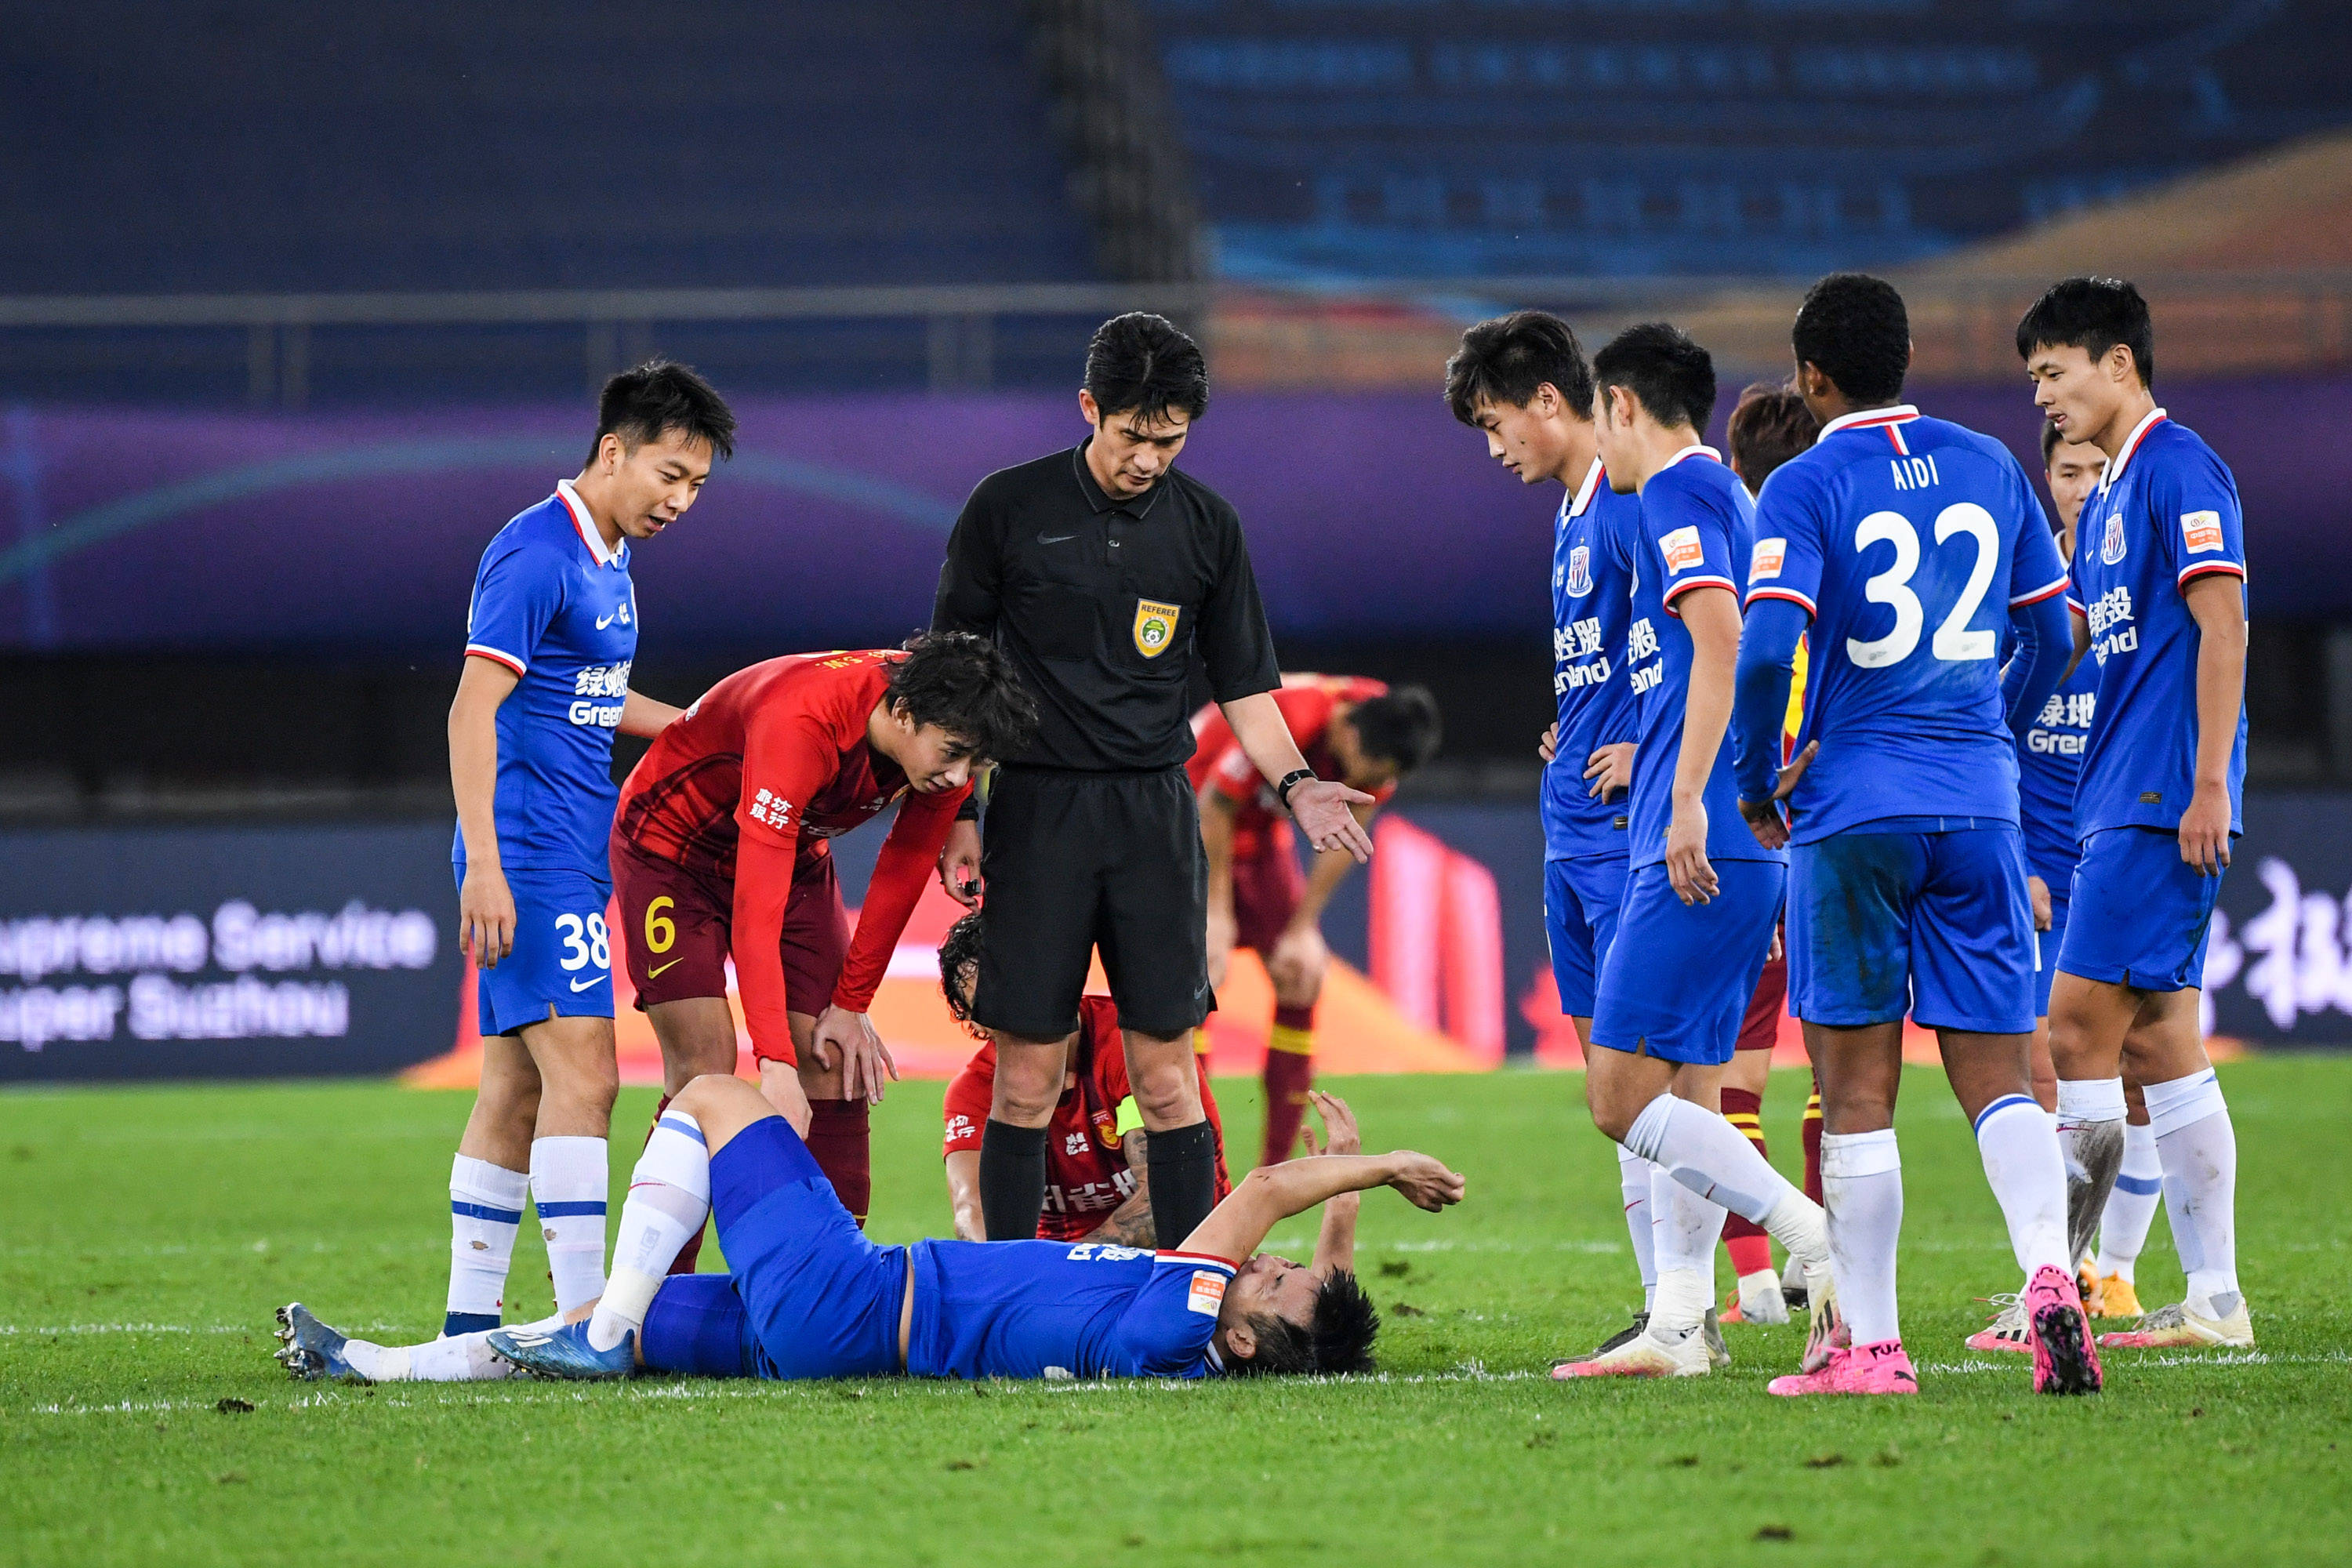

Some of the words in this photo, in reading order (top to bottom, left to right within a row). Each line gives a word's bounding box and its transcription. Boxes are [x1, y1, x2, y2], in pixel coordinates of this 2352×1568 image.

[1889, 454, 1940, 491] AIDI
[1141, 604, 1177, 617] REFEREE
[1846, 502, 1999, 669] 32
[212, 899, 437, 971] Service
[555, 913, 611, 971] 38
[644, 895, 676, 953] 6
[129, 974, 350, 1040] Suzhou
